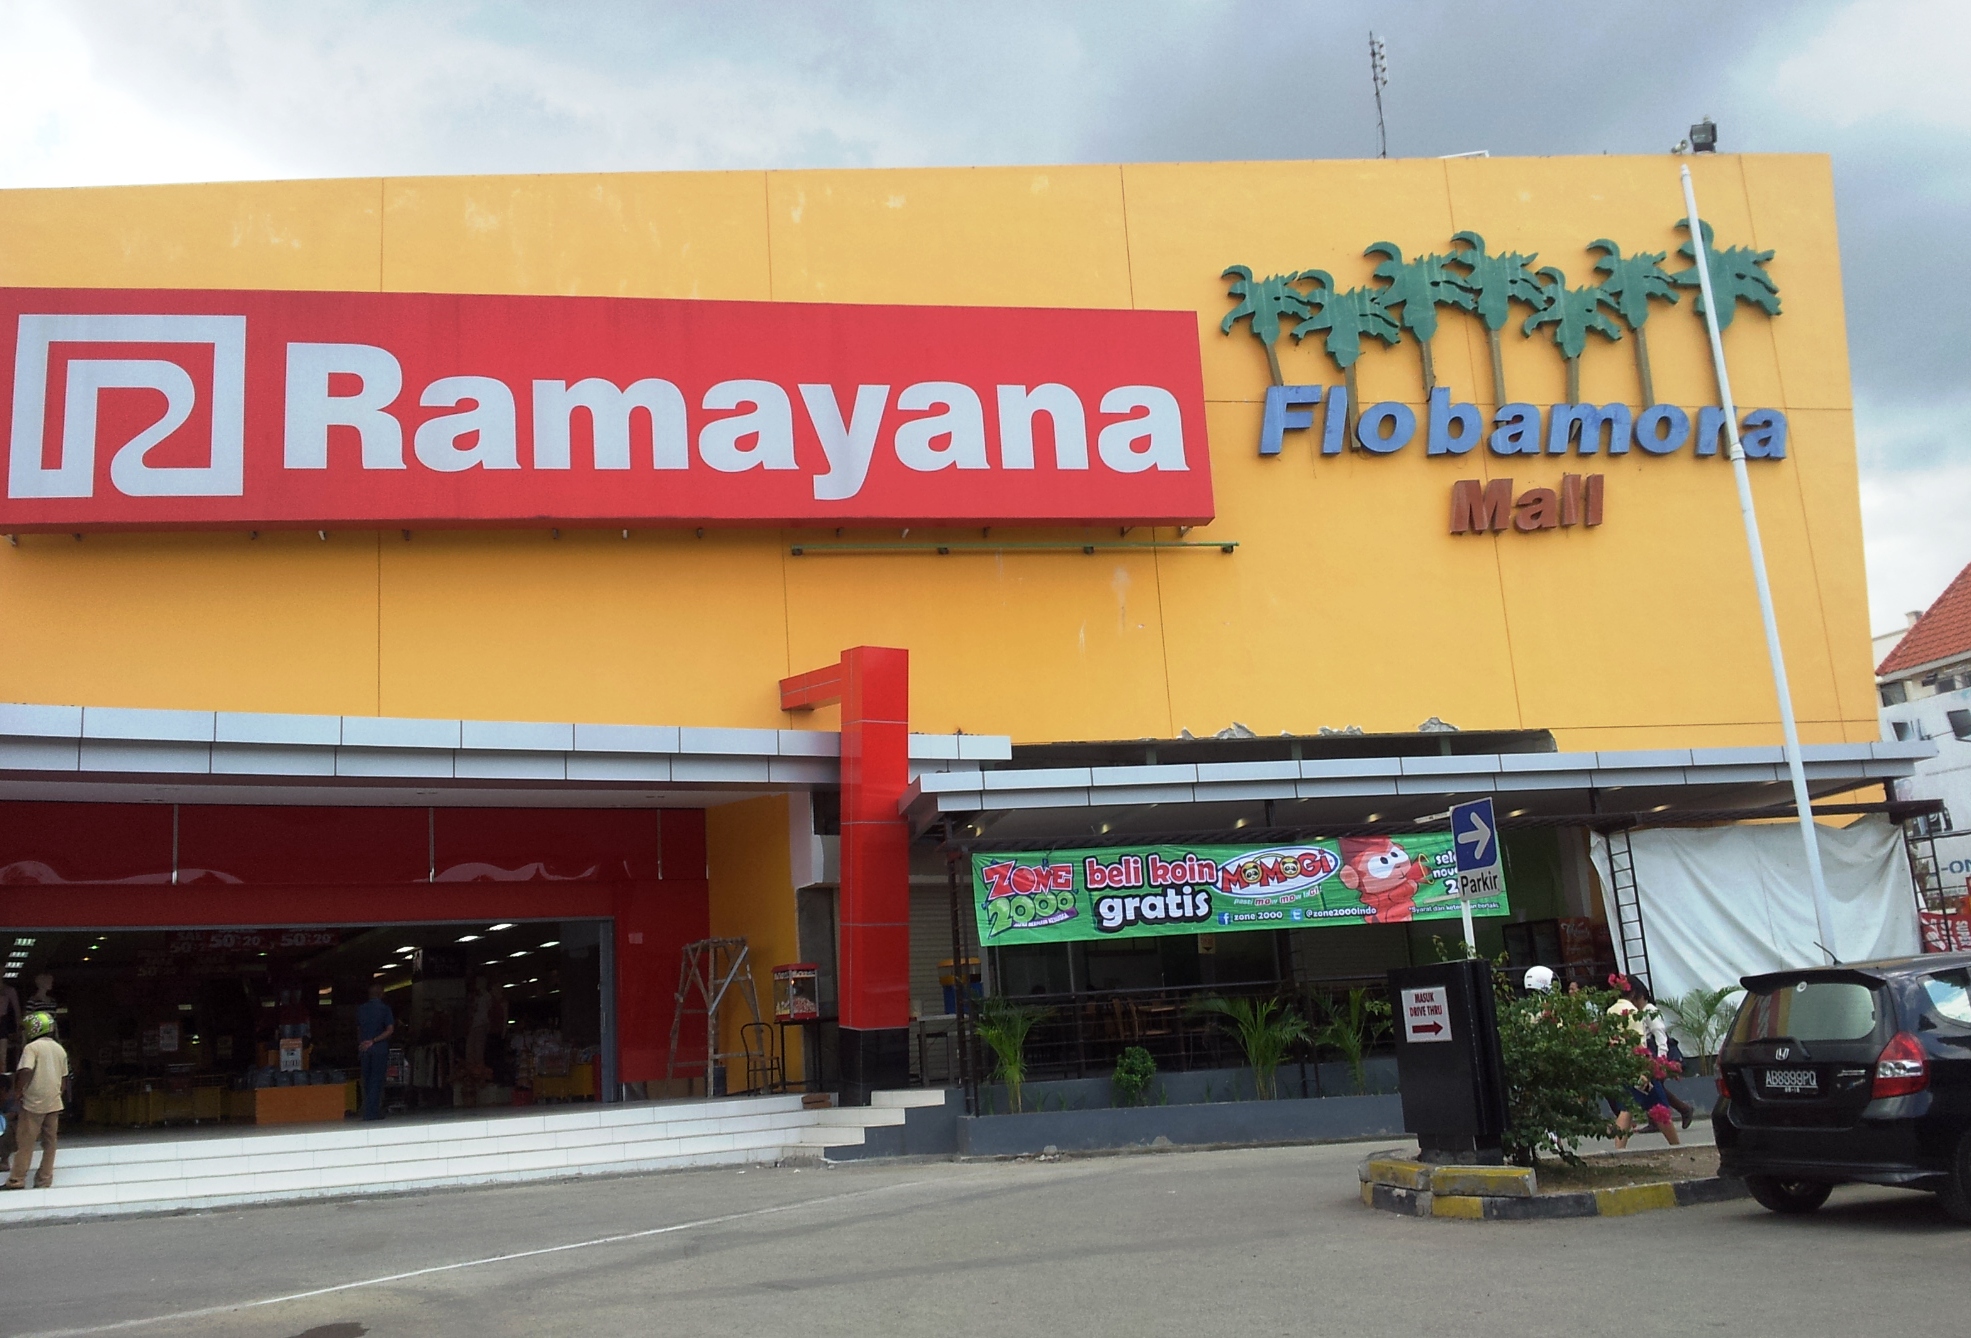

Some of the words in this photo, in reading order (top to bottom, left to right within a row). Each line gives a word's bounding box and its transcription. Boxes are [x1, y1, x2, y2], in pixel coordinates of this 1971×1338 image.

[283, 341, 1190, 501] Ramayana
[1258, 384, 1789, 461] Flobamora
[1449, 472, 1605, 536] Mall
[982, 859, 1073, 901] ZONE
[1085, 855, 1143, 889] beli
[1149, 854, 1217, 886] koin
[1460, 871, 1498, 896] Parkir
[987, 890, 1076, 940] 2000
[1099, 886, 1209, 927] gratis
[1234, 913, 1256, 921] zone
[1258, 911, 1283, 920] 2000
[1409, 1006, 1426, 1016] DRIVE
[1427, 1005, 1442, 1015] THRU
[1415, 992, 1434, 1003] MASUK
